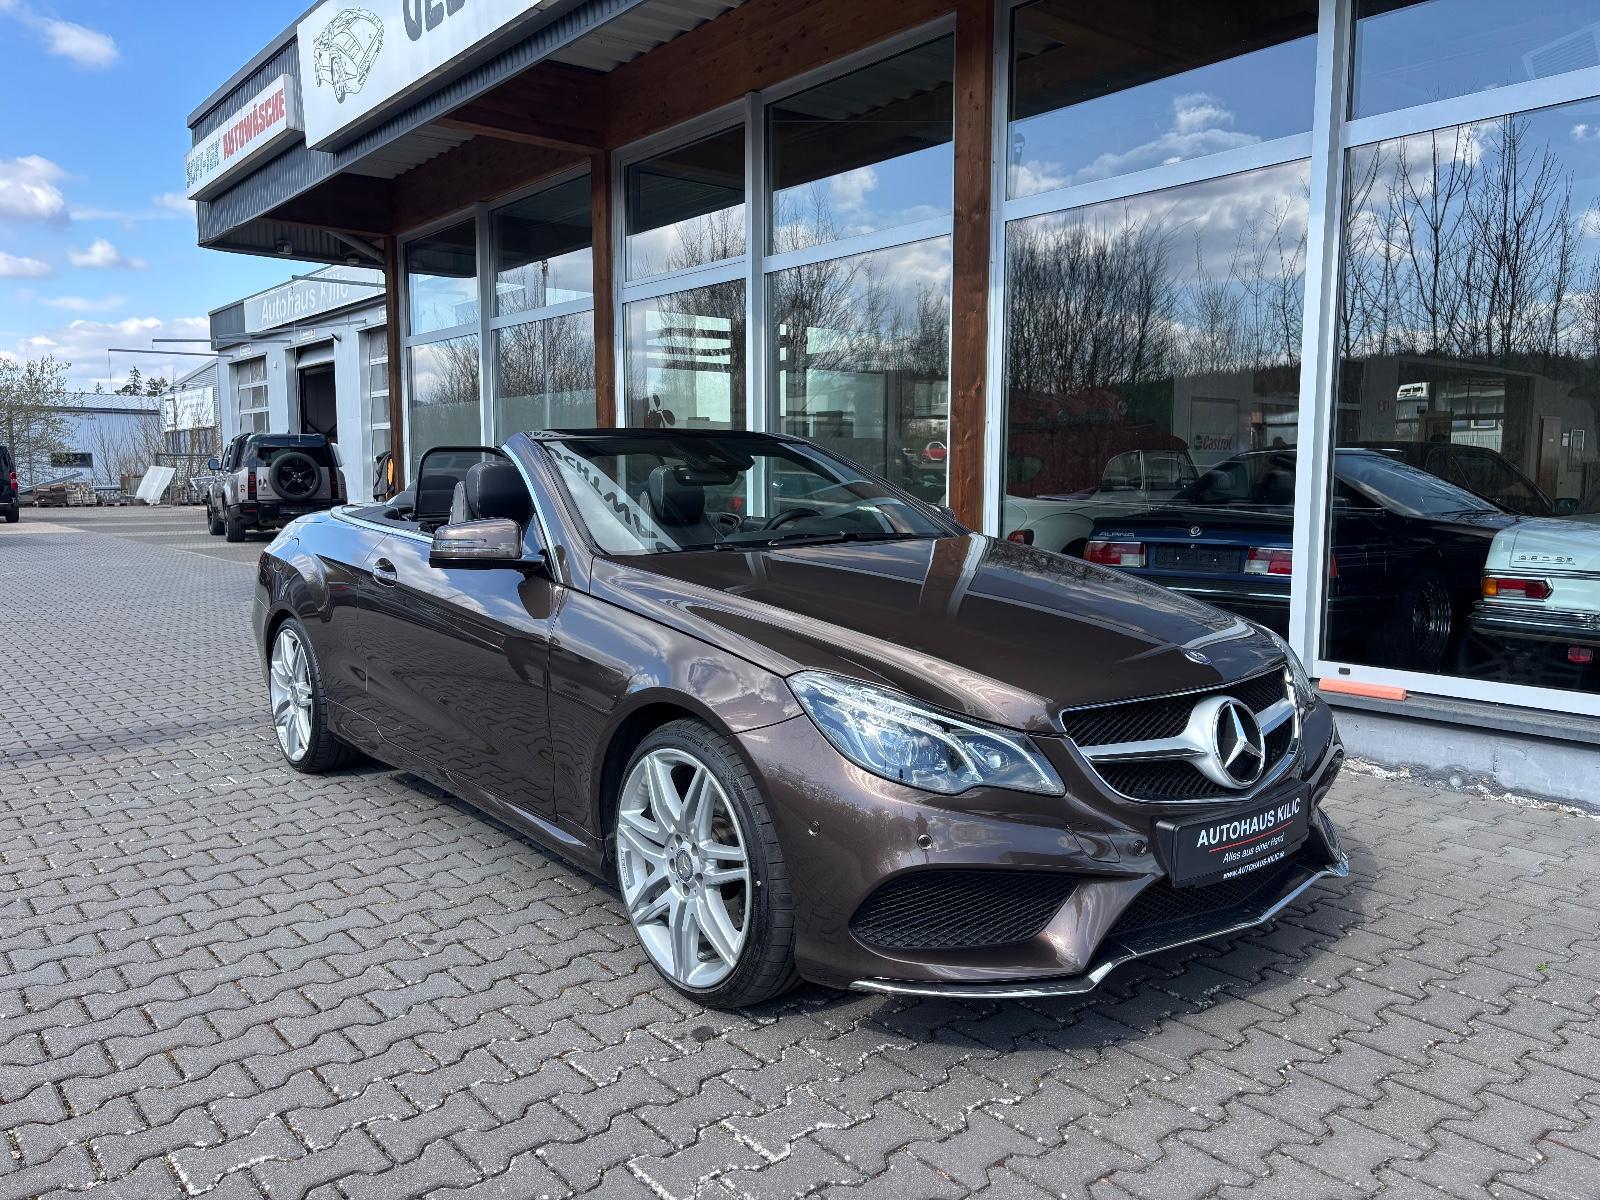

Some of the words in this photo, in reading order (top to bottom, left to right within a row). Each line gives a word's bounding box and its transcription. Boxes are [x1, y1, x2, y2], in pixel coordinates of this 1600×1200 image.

[261, 287, 317, 324] Autohaus
[1203, 435, 1232, 450] Castrol
[1099, 530, 1135, 538] ALPINA
[1197, 809, 1275, 848] AUTOHAUS
[1276, 797, 1301, 824] KILIC
[1241, 847, 1255, 858] aus
